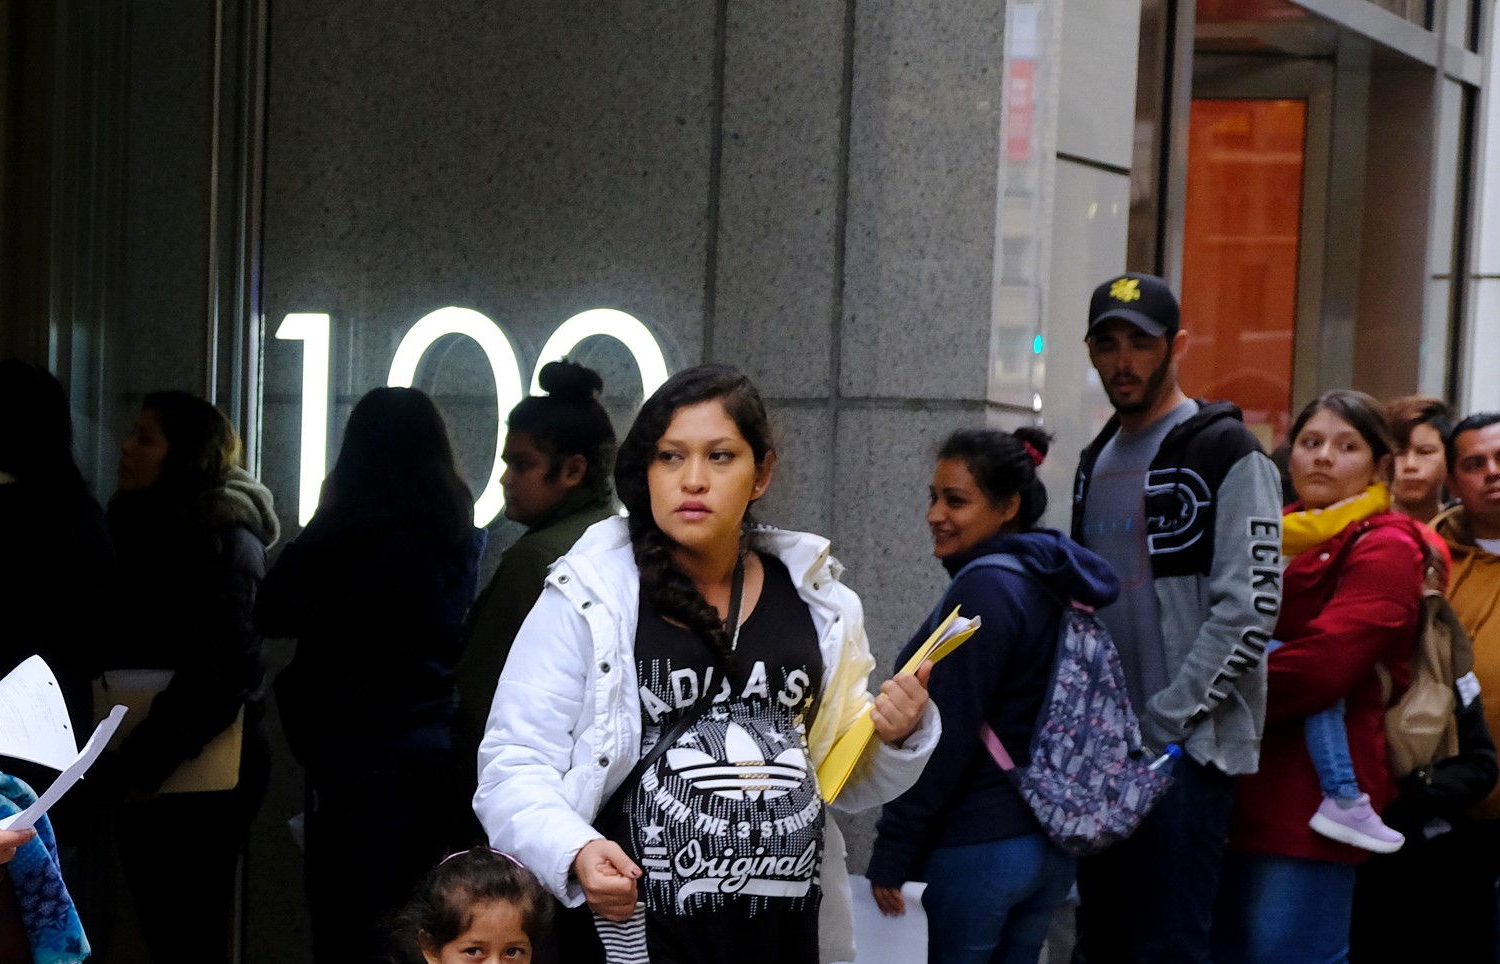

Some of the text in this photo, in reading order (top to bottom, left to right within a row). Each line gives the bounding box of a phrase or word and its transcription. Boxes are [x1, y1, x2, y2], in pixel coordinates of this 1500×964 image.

[1248, 516, 1281, 618] ECKO
[694, 812, 730, 837] THE
[737, 821, 750, 838] 3
[674, 838, 818, 893] Originals
